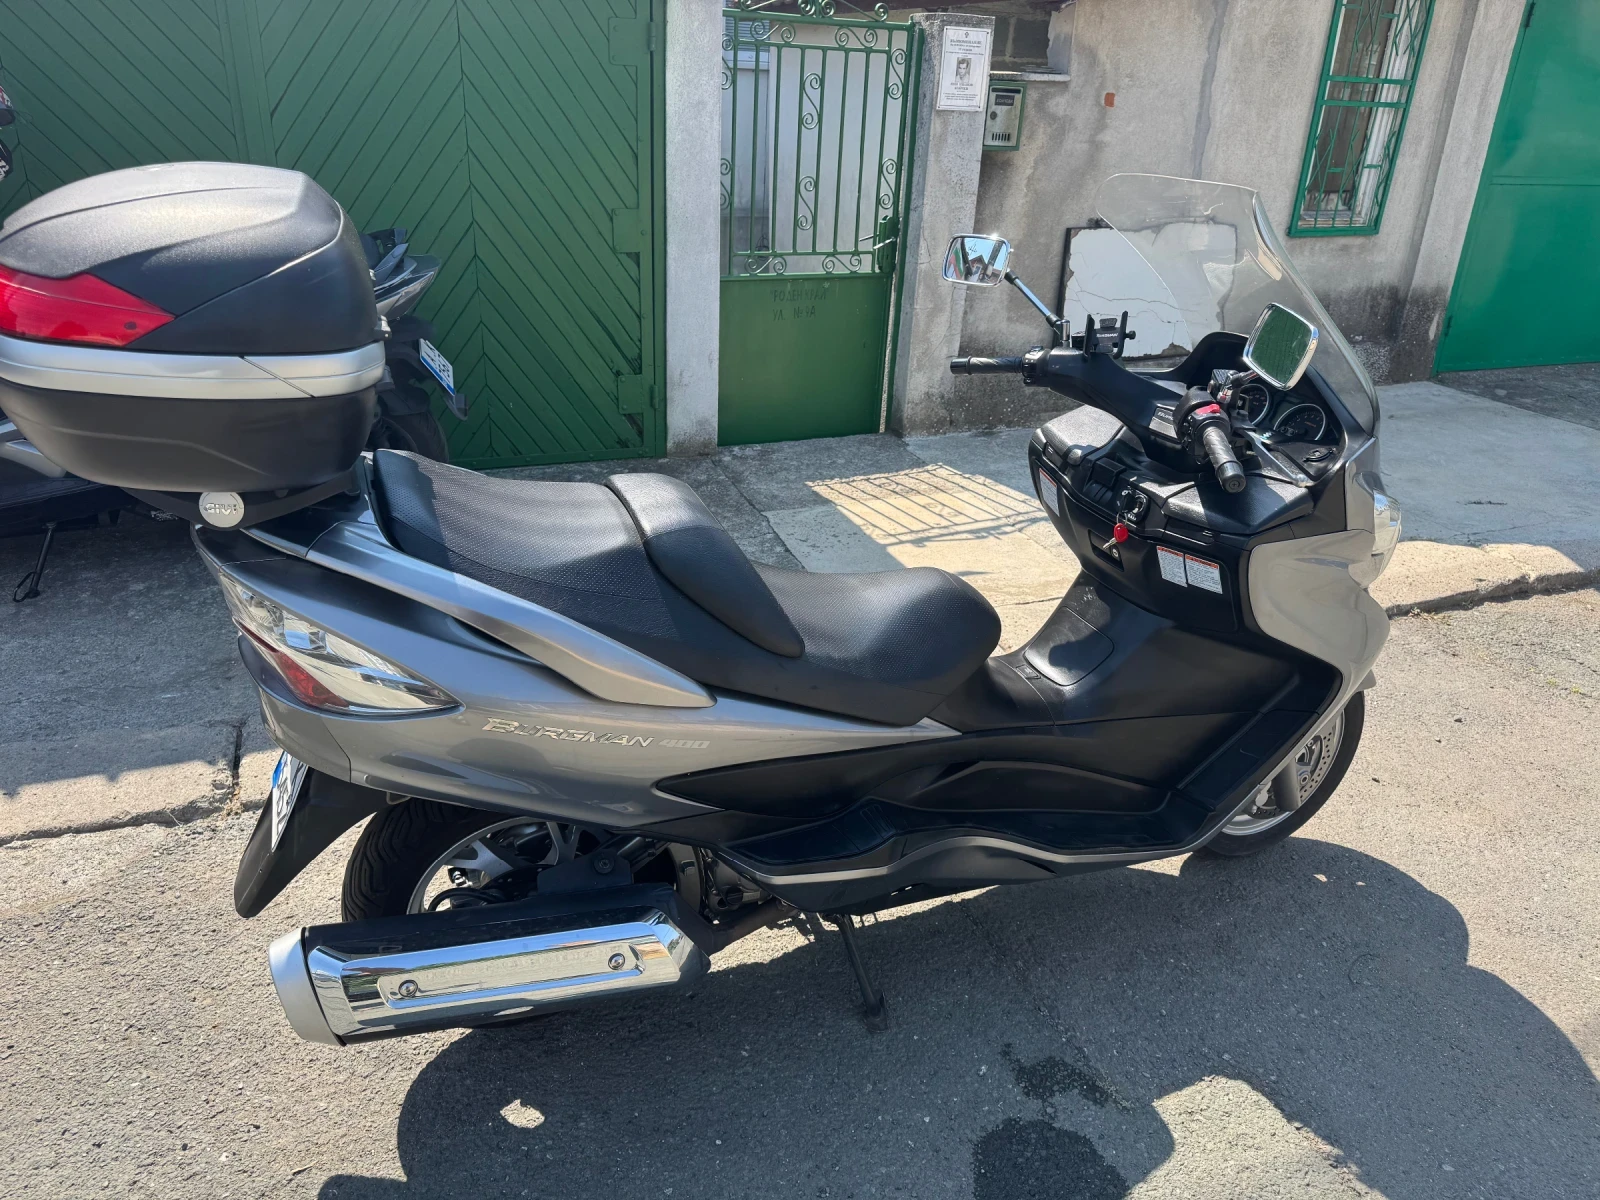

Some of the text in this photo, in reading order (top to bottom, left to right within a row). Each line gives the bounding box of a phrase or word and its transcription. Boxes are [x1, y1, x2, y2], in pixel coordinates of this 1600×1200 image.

[204, 502, 238, 515] GIVI
[482, 717, 711, 749] BURGMAN 400
